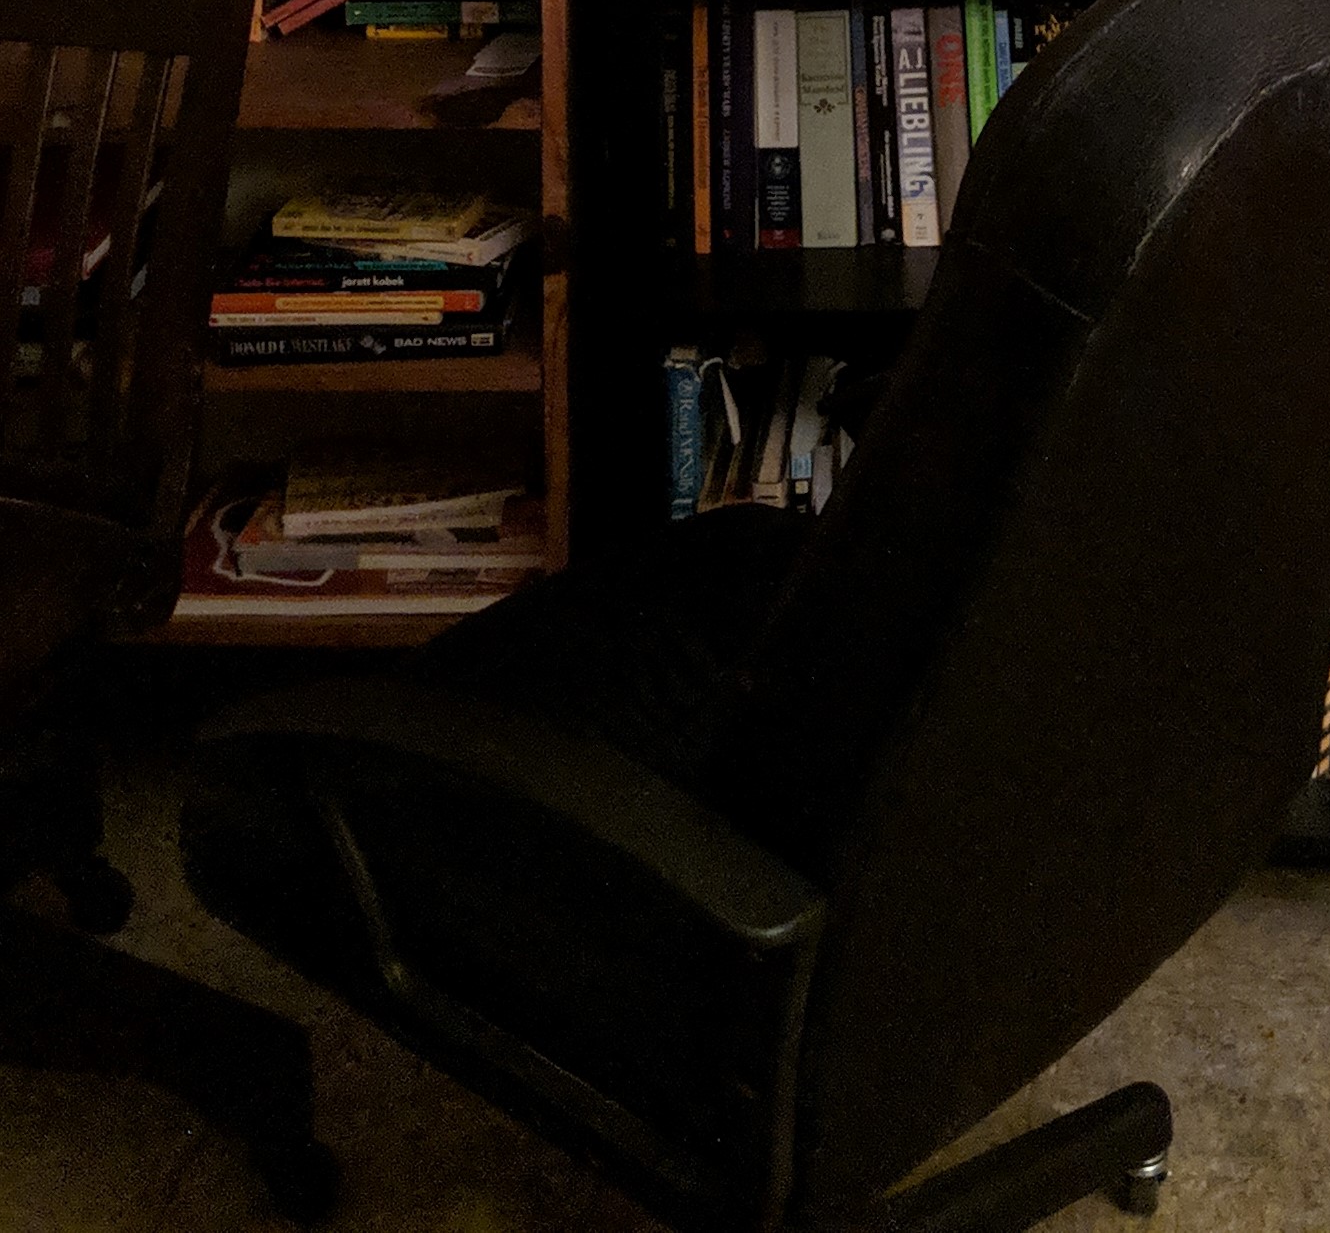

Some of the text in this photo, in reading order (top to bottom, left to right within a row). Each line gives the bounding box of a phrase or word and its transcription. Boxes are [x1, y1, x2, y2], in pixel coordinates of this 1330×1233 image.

[936, 34, 965, 108] ONE
[899, 72, 934, 192] LIEBLING
[394, 336, 467, 348] BAD NEWS
